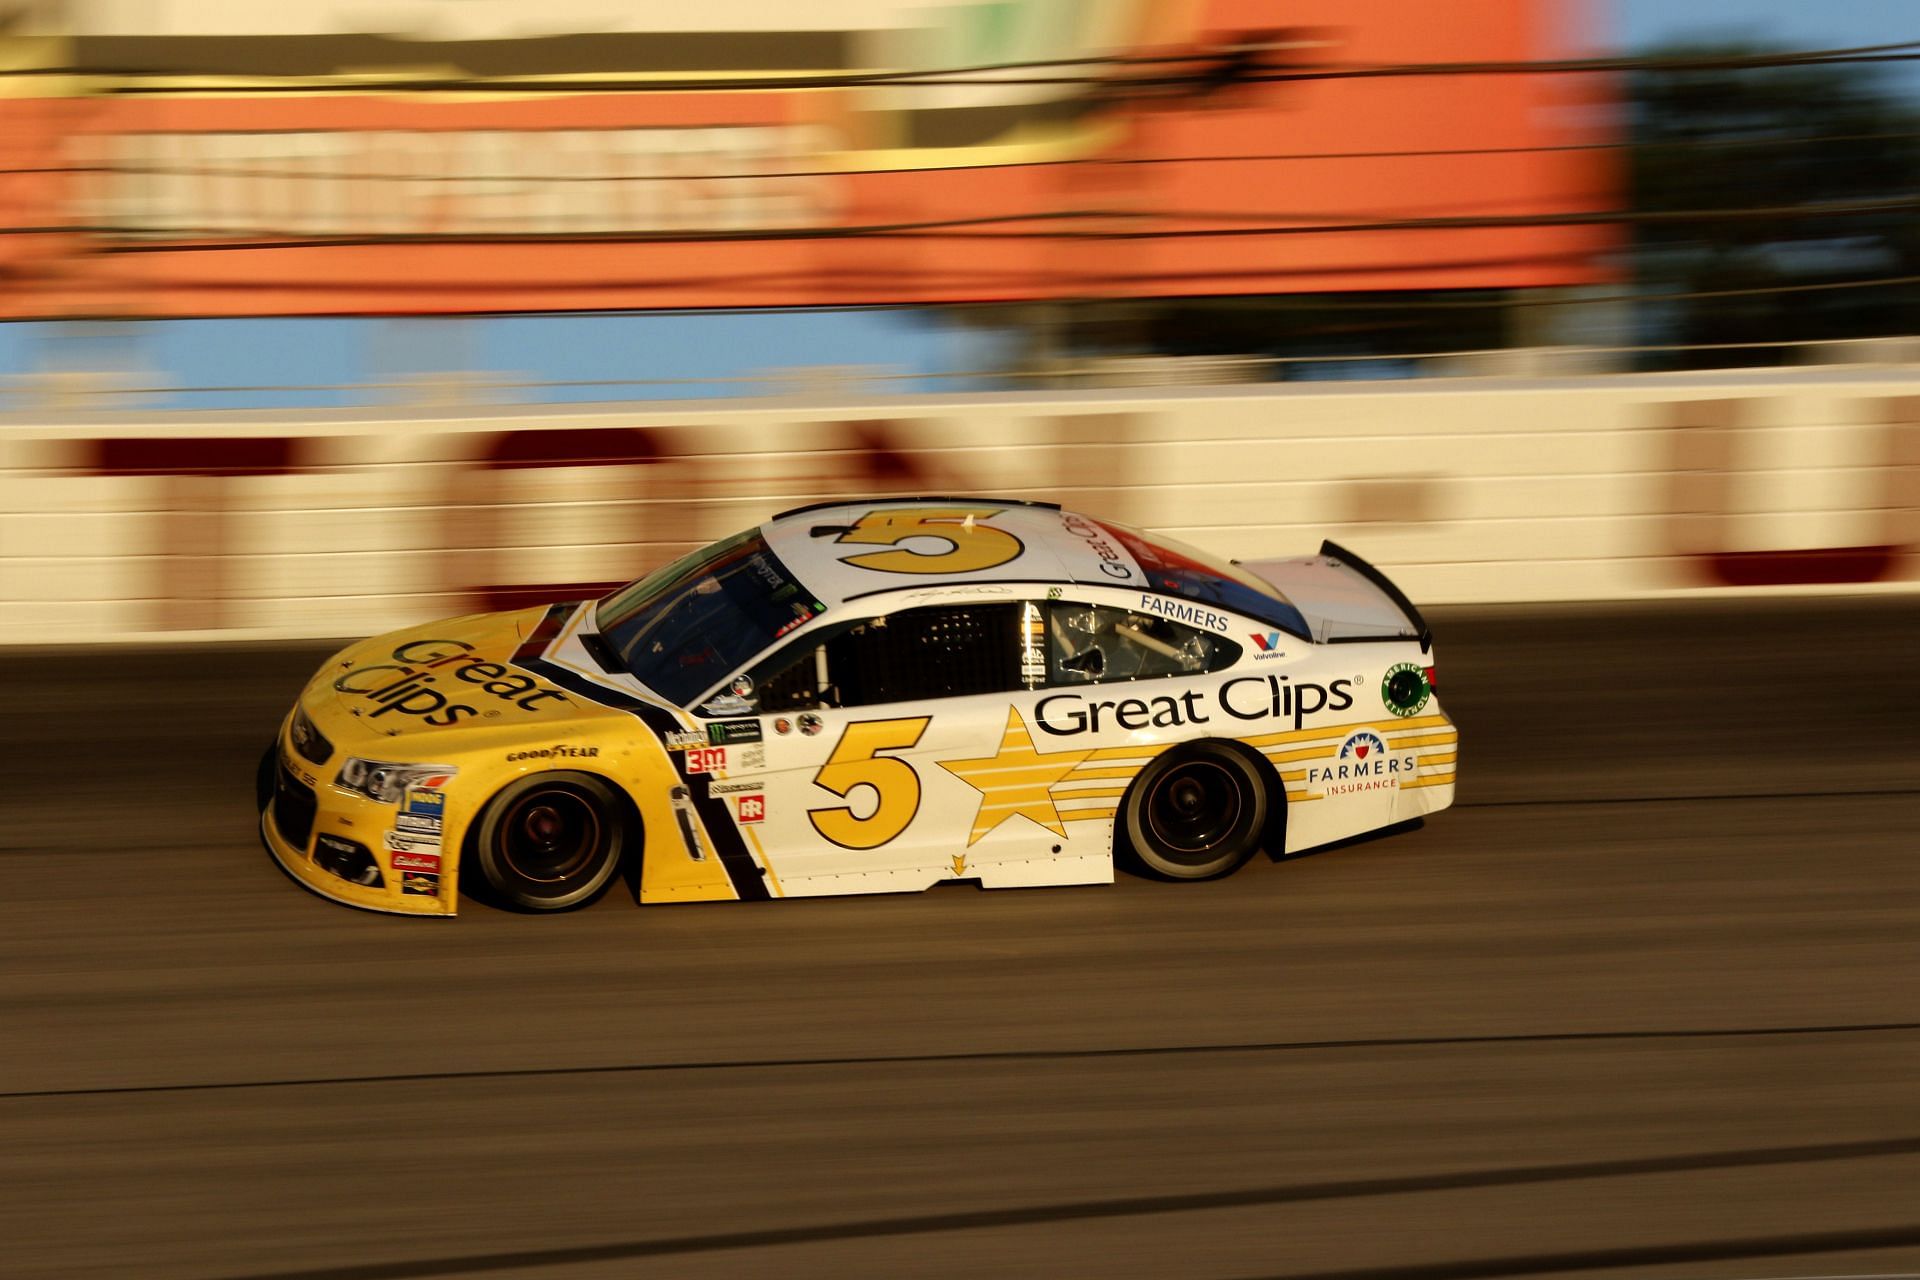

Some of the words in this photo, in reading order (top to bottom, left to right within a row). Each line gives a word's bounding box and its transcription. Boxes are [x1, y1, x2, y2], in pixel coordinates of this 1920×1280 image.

[833, 508, 1026, 575] 5
[1141, 594, 1230, 632] FARMERS
[1252, 651, 1287, 661] Valvoline
[392, 639, 570, 711] Great
[1383, 662, 1430, 687] AMERICAN
[333, 664, 479, 727] Clips
[1384, 693, 1429, 717] ETHANOL
[1034, 689, 1210, 736] Great
[506, 744, 599, 762] GOODYEAR
[687, 747, 726, 773] 3M
[807, 715, 933, 851] 5
[1309, 756, 1415, 783] FARMERS
[1327, 778, 1397, 796] INSURANCE
